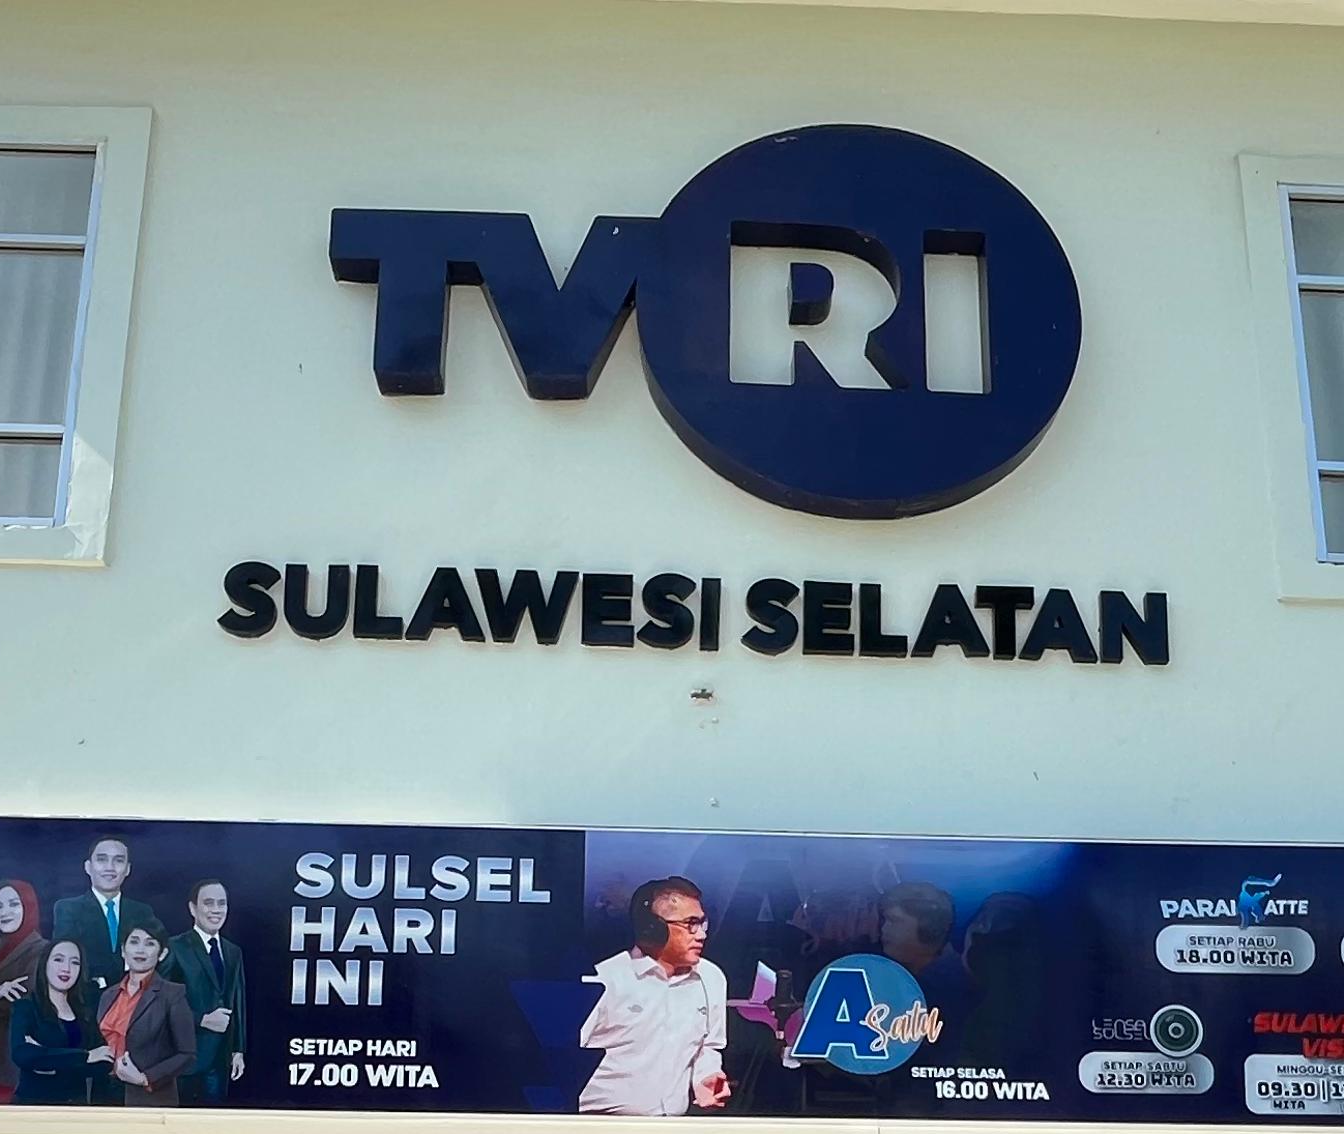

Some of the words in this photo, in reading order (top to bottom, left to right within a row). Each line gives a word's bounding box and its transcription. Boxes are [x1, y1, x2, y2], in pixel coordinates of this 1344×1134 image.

[330, 208, 989, 399] TVRI
[218, 561, 722, 651] SULAWESI
[741, 577, 1171, 667] SELATAN
[293, 852, 551, 904] SULSEL
[289, 906, 456, 955] HARI
[1189, 935, 1234, 946] SETIAP
[1238, 936, 1275, 947] RABU
[1176, 949, 1235, 964] 18.00
[1241, 950, 1292, 965] WITA
[291, 958, 385, 1006] INI
[791, 968, 889, 1060] A
[289, 1038, 363, 1057] SETIAP
[366, 1040, 417, 1057] HARI
[289, 1063, 359, 1087] 17.00
[365, 1064, 439, 1088] WITA
[911, 1066, 955, 1079] SETIAP
[957, 1067, 1006, 1080] SELASA
[1103, 1061, 1143, 1071] SETIAP
[1097, 1073, 1145, 1086] 12.30
[1150, 1074, 1195, 1087] WITA
[1257, 1081, 1316, 1097] 09.30
[935, 1081, 989, 1099] 16.00
[994, 1082, 1050, 1100] WITA
[1273, 1100, 1306, 1110] WITA
